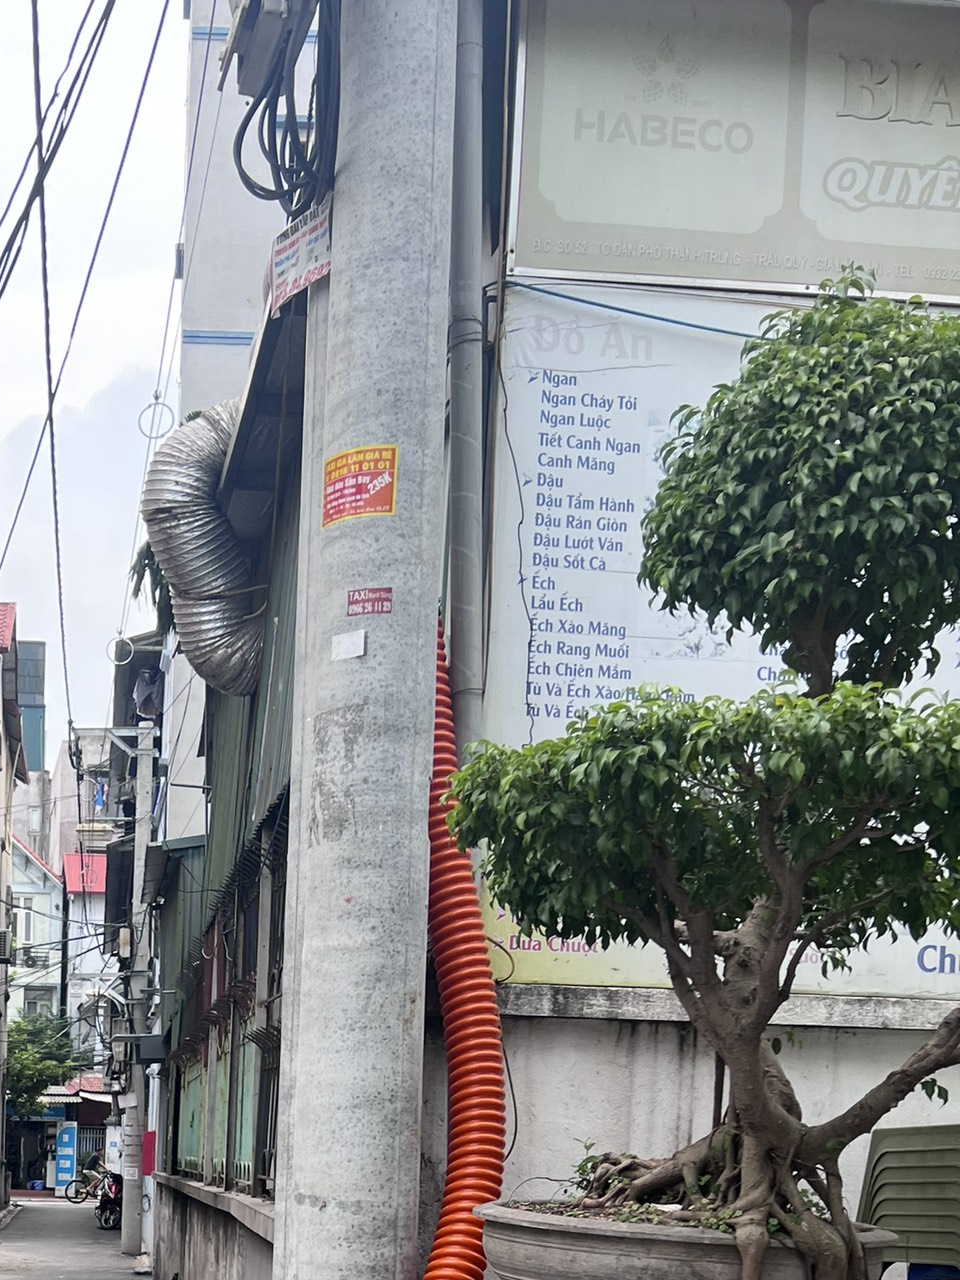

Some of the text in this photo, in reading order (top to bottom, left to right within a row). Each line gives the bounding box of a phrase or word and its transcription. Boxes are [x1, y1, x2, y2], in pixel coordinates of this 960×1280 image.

[573, 108, 754, 155] HABECO
[824, 156, 960, 213] QUYÊ
[533, 313, 654, 361] Đồ Ăn
[542, 369, 577, 388] Ngan
[541, 390, 638, 412] Ngan Cháy Tỏi
[540, 410, 611, 431] Ngan Luộc
[538, 432, 641, 456] Tiết Canh Ngan
[362, 462, 374, 470] 01
[378, 461, 390, 469] 01
[537, 453, 615, 475] Canh Măng
[537, 473, 563, 491] Đậu
[536, 492, 635, 512] Đậu Tẩm Hành
[535, 512, 627, 532] Đậu Rán Giòn
[533, 532, 623, 552] Đậu Lướt Ván
[532, 552, 606, 571] Đậu Sốt Cà
[532, 569, 556, 590] Ếch
[349, 589, 368, 601] TAXI
[531, 591, 583, 612] Lẩu Ếch
[530, 612, 626, 640] Ếch Xào Măng
[528, 633, 630, 660] Ếch Rang Muối
[528, 655, 632, 680] Ếch Chiên Mắm
[546, 682, 562, 697] Và
[567, 678, 590, 698] Ếch
[595, 685, 621, 700] Xào
[545, 703, 561, 718] Và
